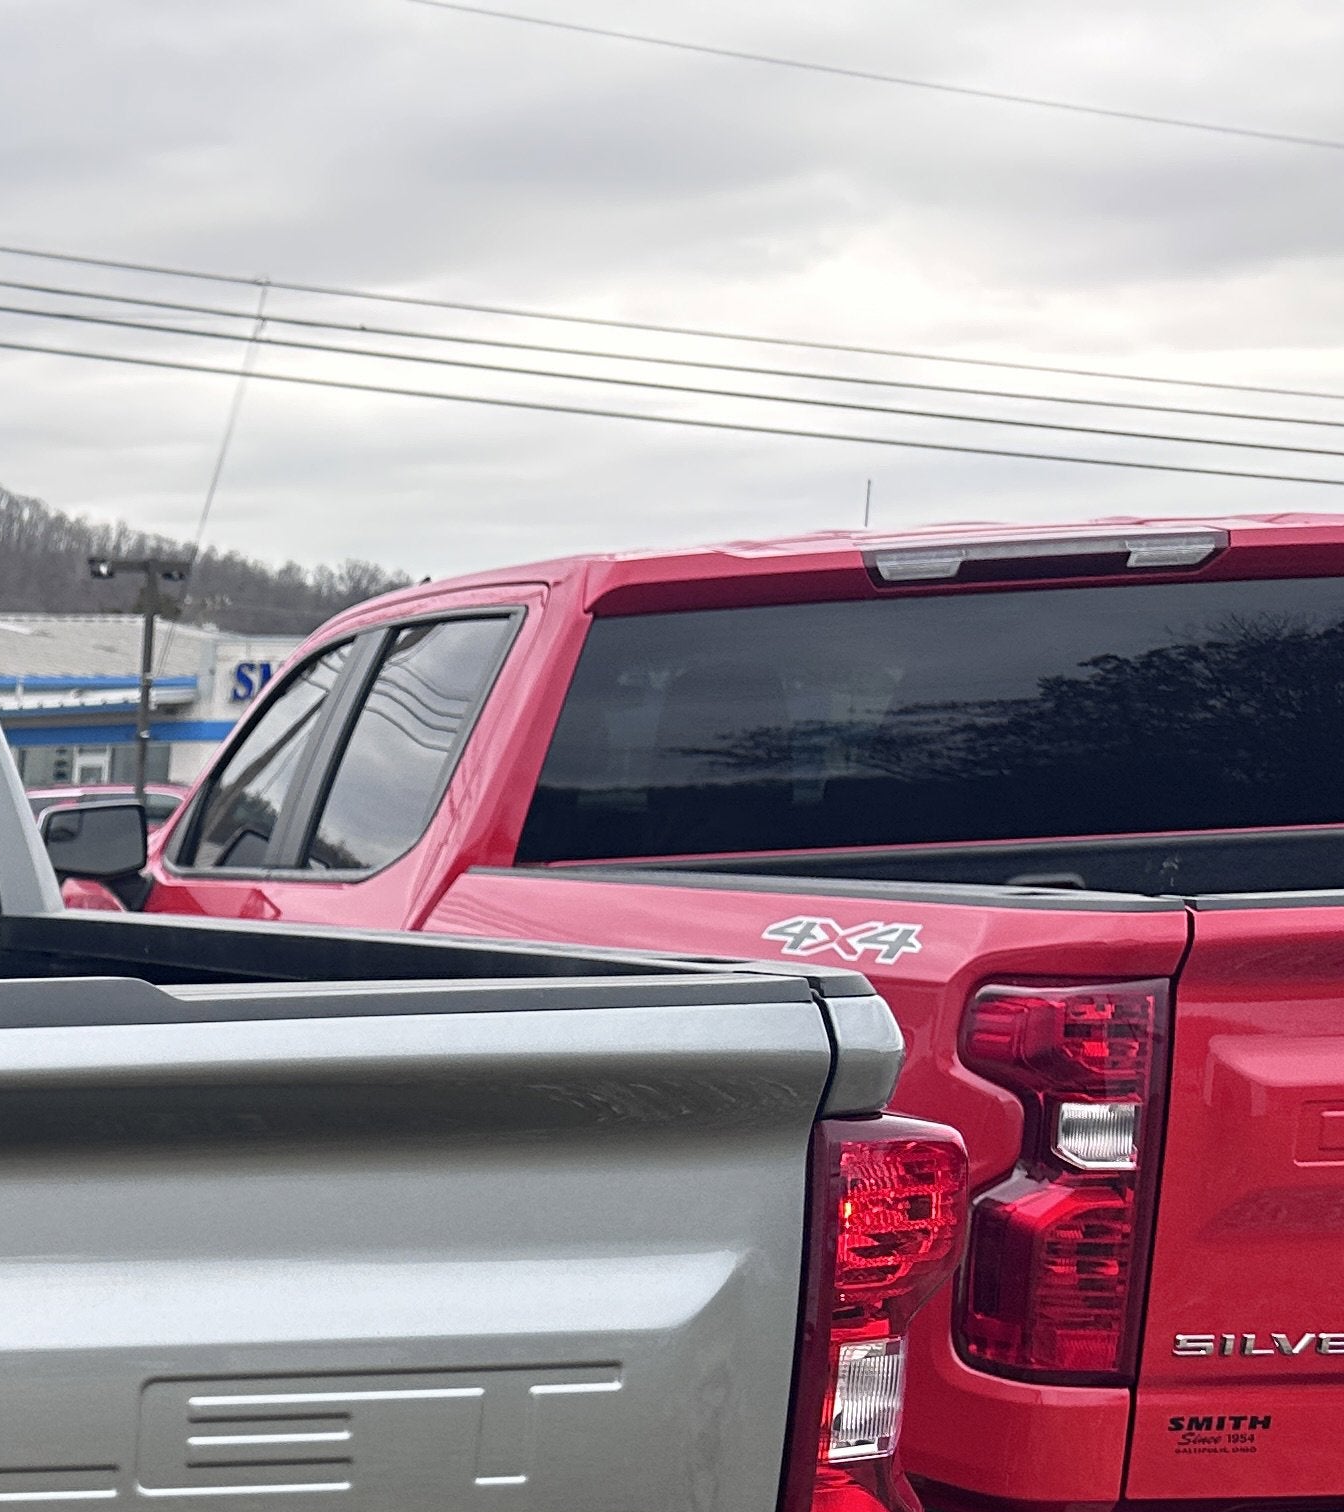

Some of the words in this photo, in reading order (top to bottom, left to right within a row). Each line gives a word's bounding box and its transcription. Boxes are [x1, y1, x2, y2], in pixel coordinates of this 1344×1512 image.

[1167, 1415, 1272, 1431] SMITH
[1177, 1432, 1223, 1446] Since
[1227, 1433, 1255, 1444] 1954
